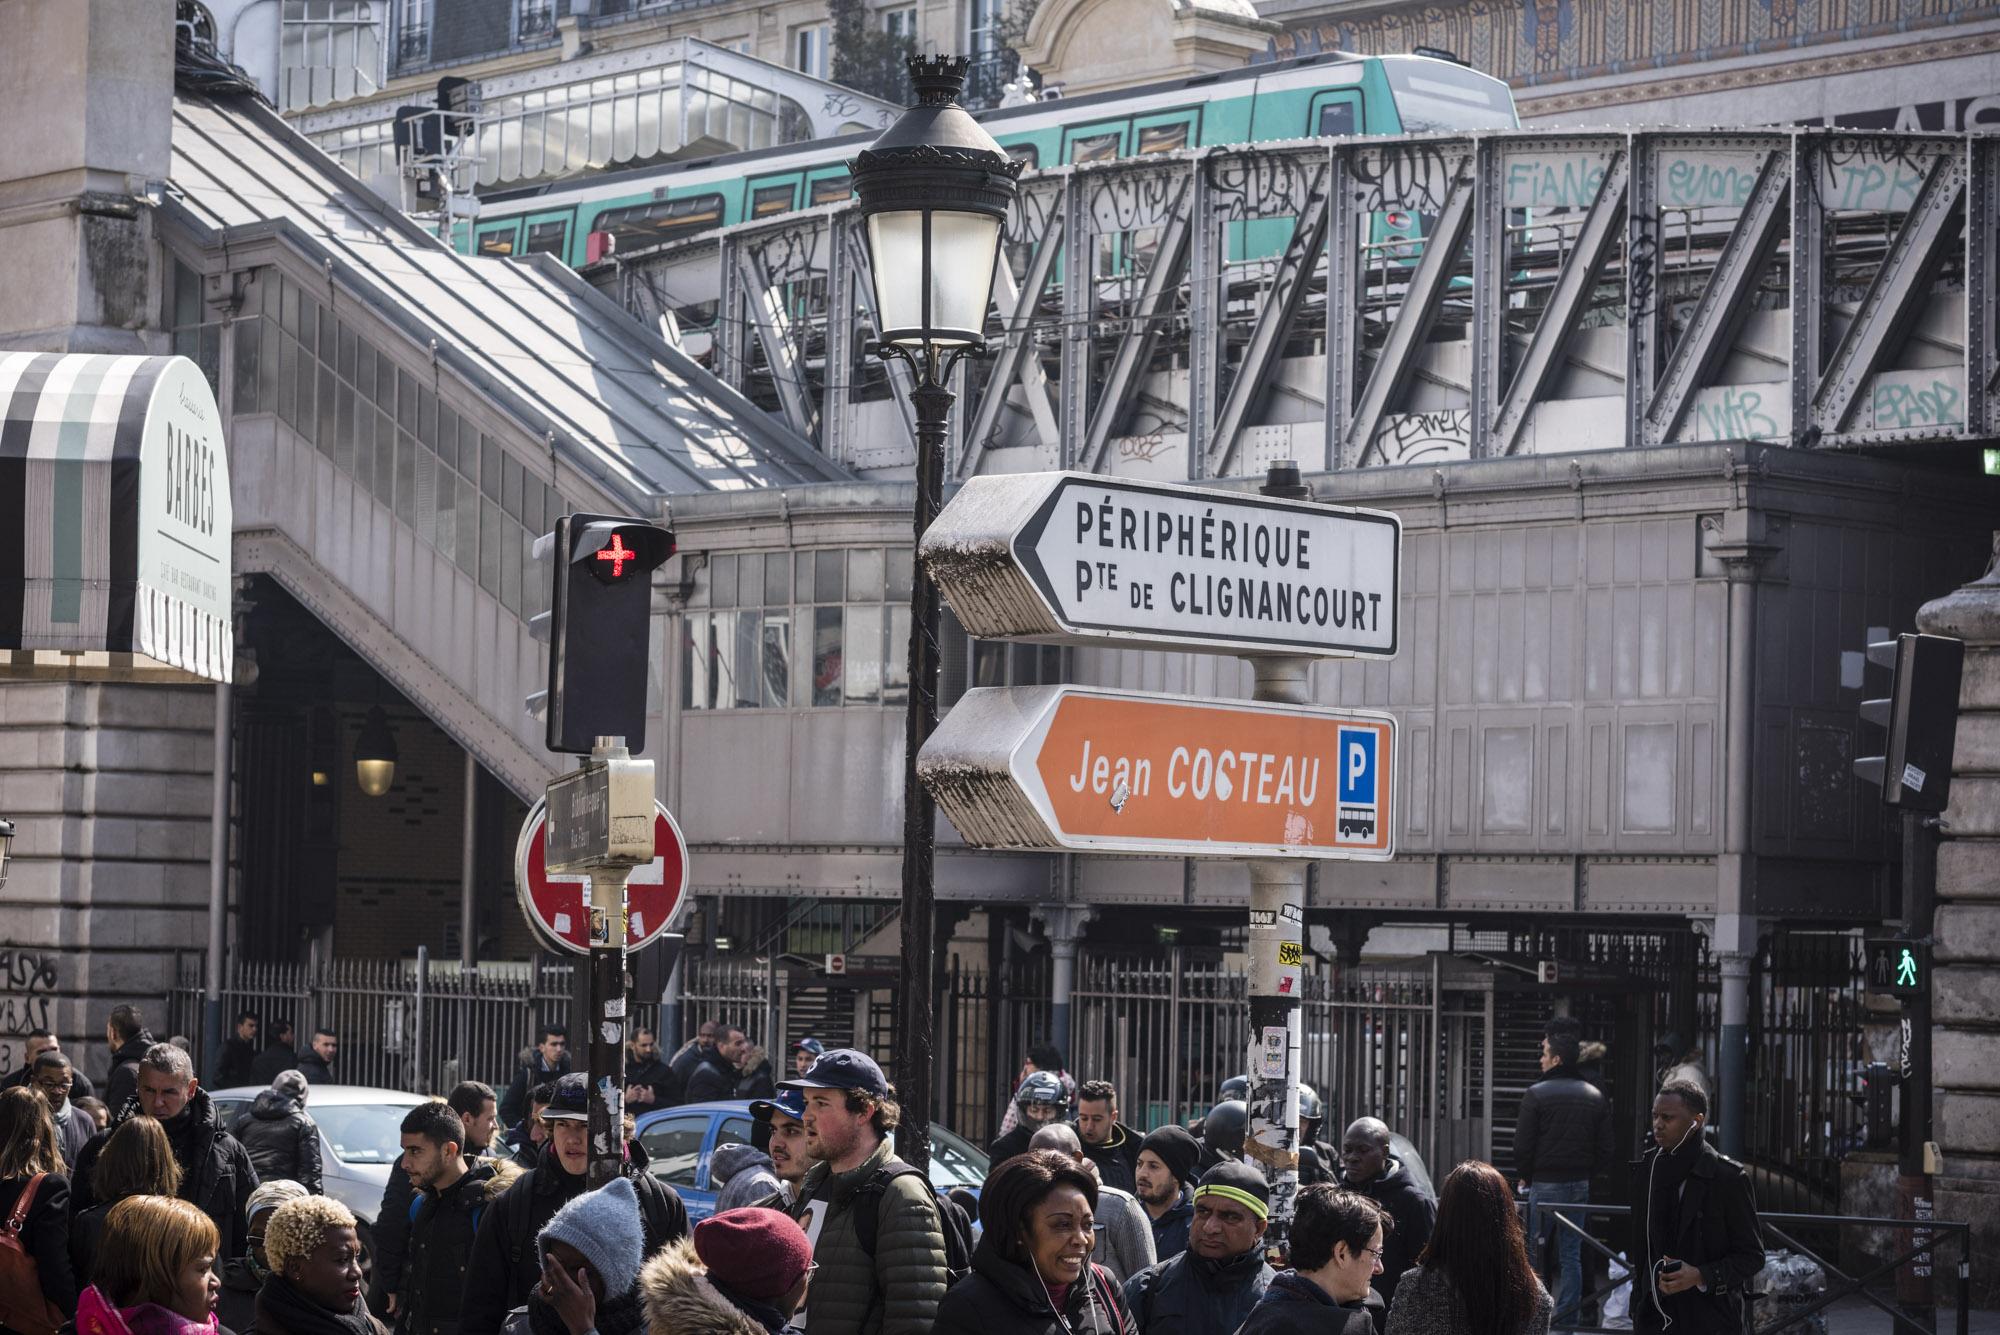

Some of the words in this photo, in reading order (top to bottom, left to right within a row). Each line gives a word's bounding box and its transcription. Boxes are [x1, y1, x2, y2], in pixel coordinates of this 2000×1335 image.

[1076, 495, 1310, 570] PÉRIPHÉRIQUE
[1130, 582, 1154, 610] DE
[1170, 572, 1382, 632] CLIGNANCOURT
[1070, 740, 1152, 797] Jean
[1348, 742, 1367, 791] P
